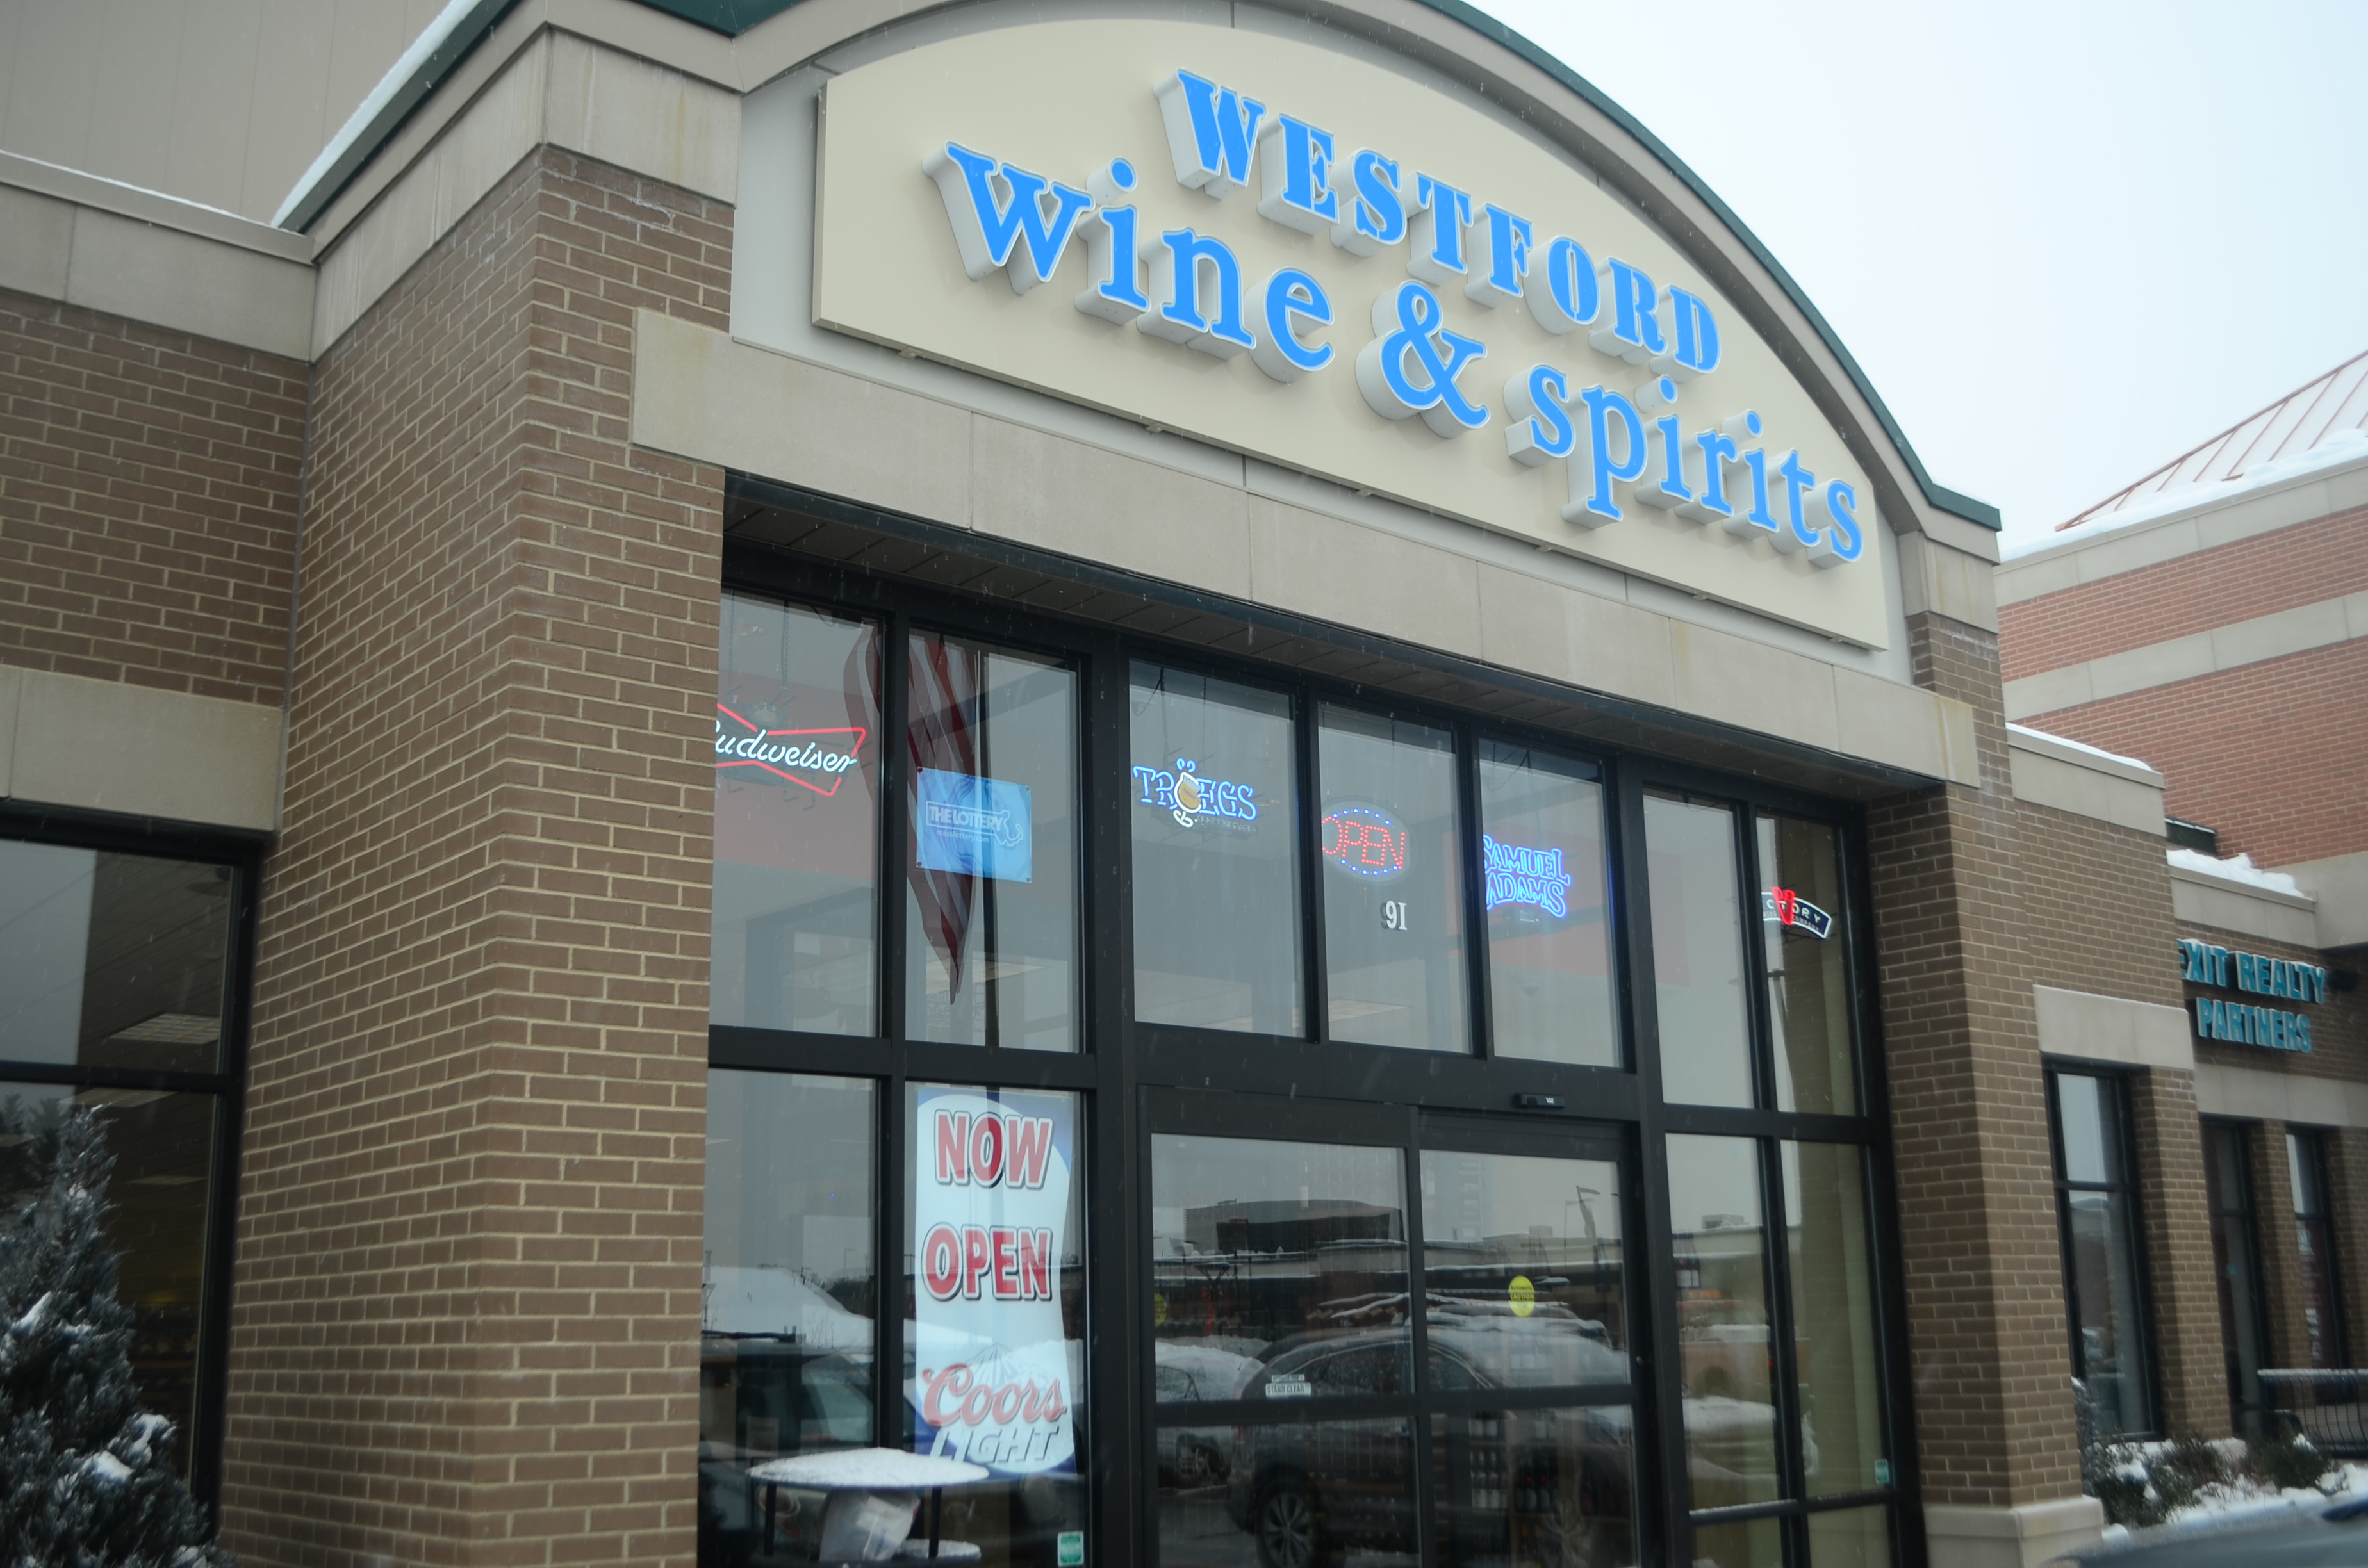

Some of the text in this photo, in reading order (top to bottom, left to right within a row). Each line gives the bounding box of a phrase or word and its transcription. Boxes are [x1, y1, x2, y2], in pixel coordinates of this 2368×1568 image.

[1175, 68, 1721, 375] WESTFORD
[944, 142, 1864, 563] wine & spirits
[929, 806, 1004, 831] THE LOTTERY
[937, 830, 989, 843] masslottery.com
[1322, 815, 1406, 870] OPEN
[1385, 901, 1407, 931] 91
[1486, 872, 1566, 918] ADAMS
[2235, 951, 2325, 1004] REALTY
[2196, 997, 2312, 1052] PARTNERS
[935, 1109, 1053, 1190] NOW
[921, 1222, 1053, 1302] OPEN
[922, 1363, 1066, 1427] Coors
[929, 1427, 1059, 1464] LIGHT
